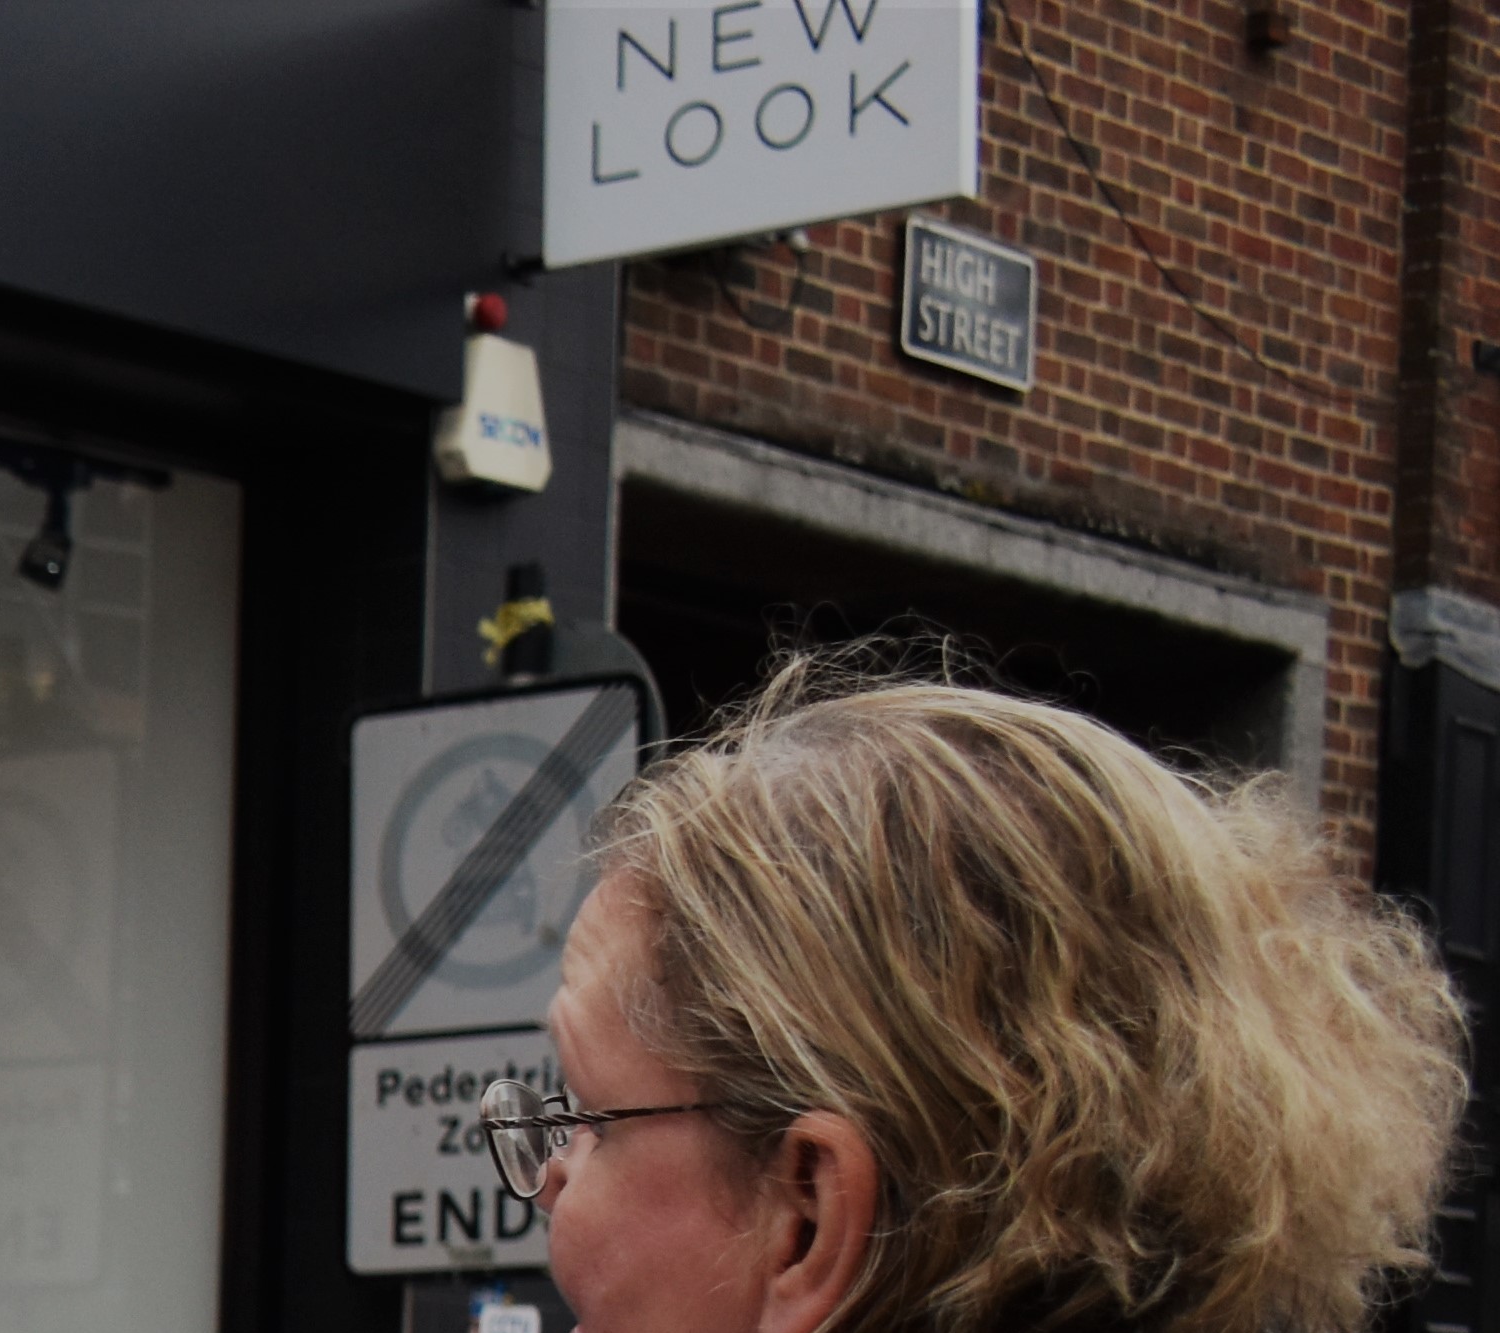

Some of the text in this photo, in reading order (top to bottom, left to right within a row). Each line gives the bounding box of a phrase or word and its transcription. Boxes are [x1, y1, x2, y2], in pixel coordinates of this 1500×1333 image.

[616, 0, 878, 91] NEW
[592, 60, 912, 185] LOOK
[920, 239, 998, 308] HIGH
[917, 299, 1024, 369] STREET
[393, 1185, 549, 1246] END
